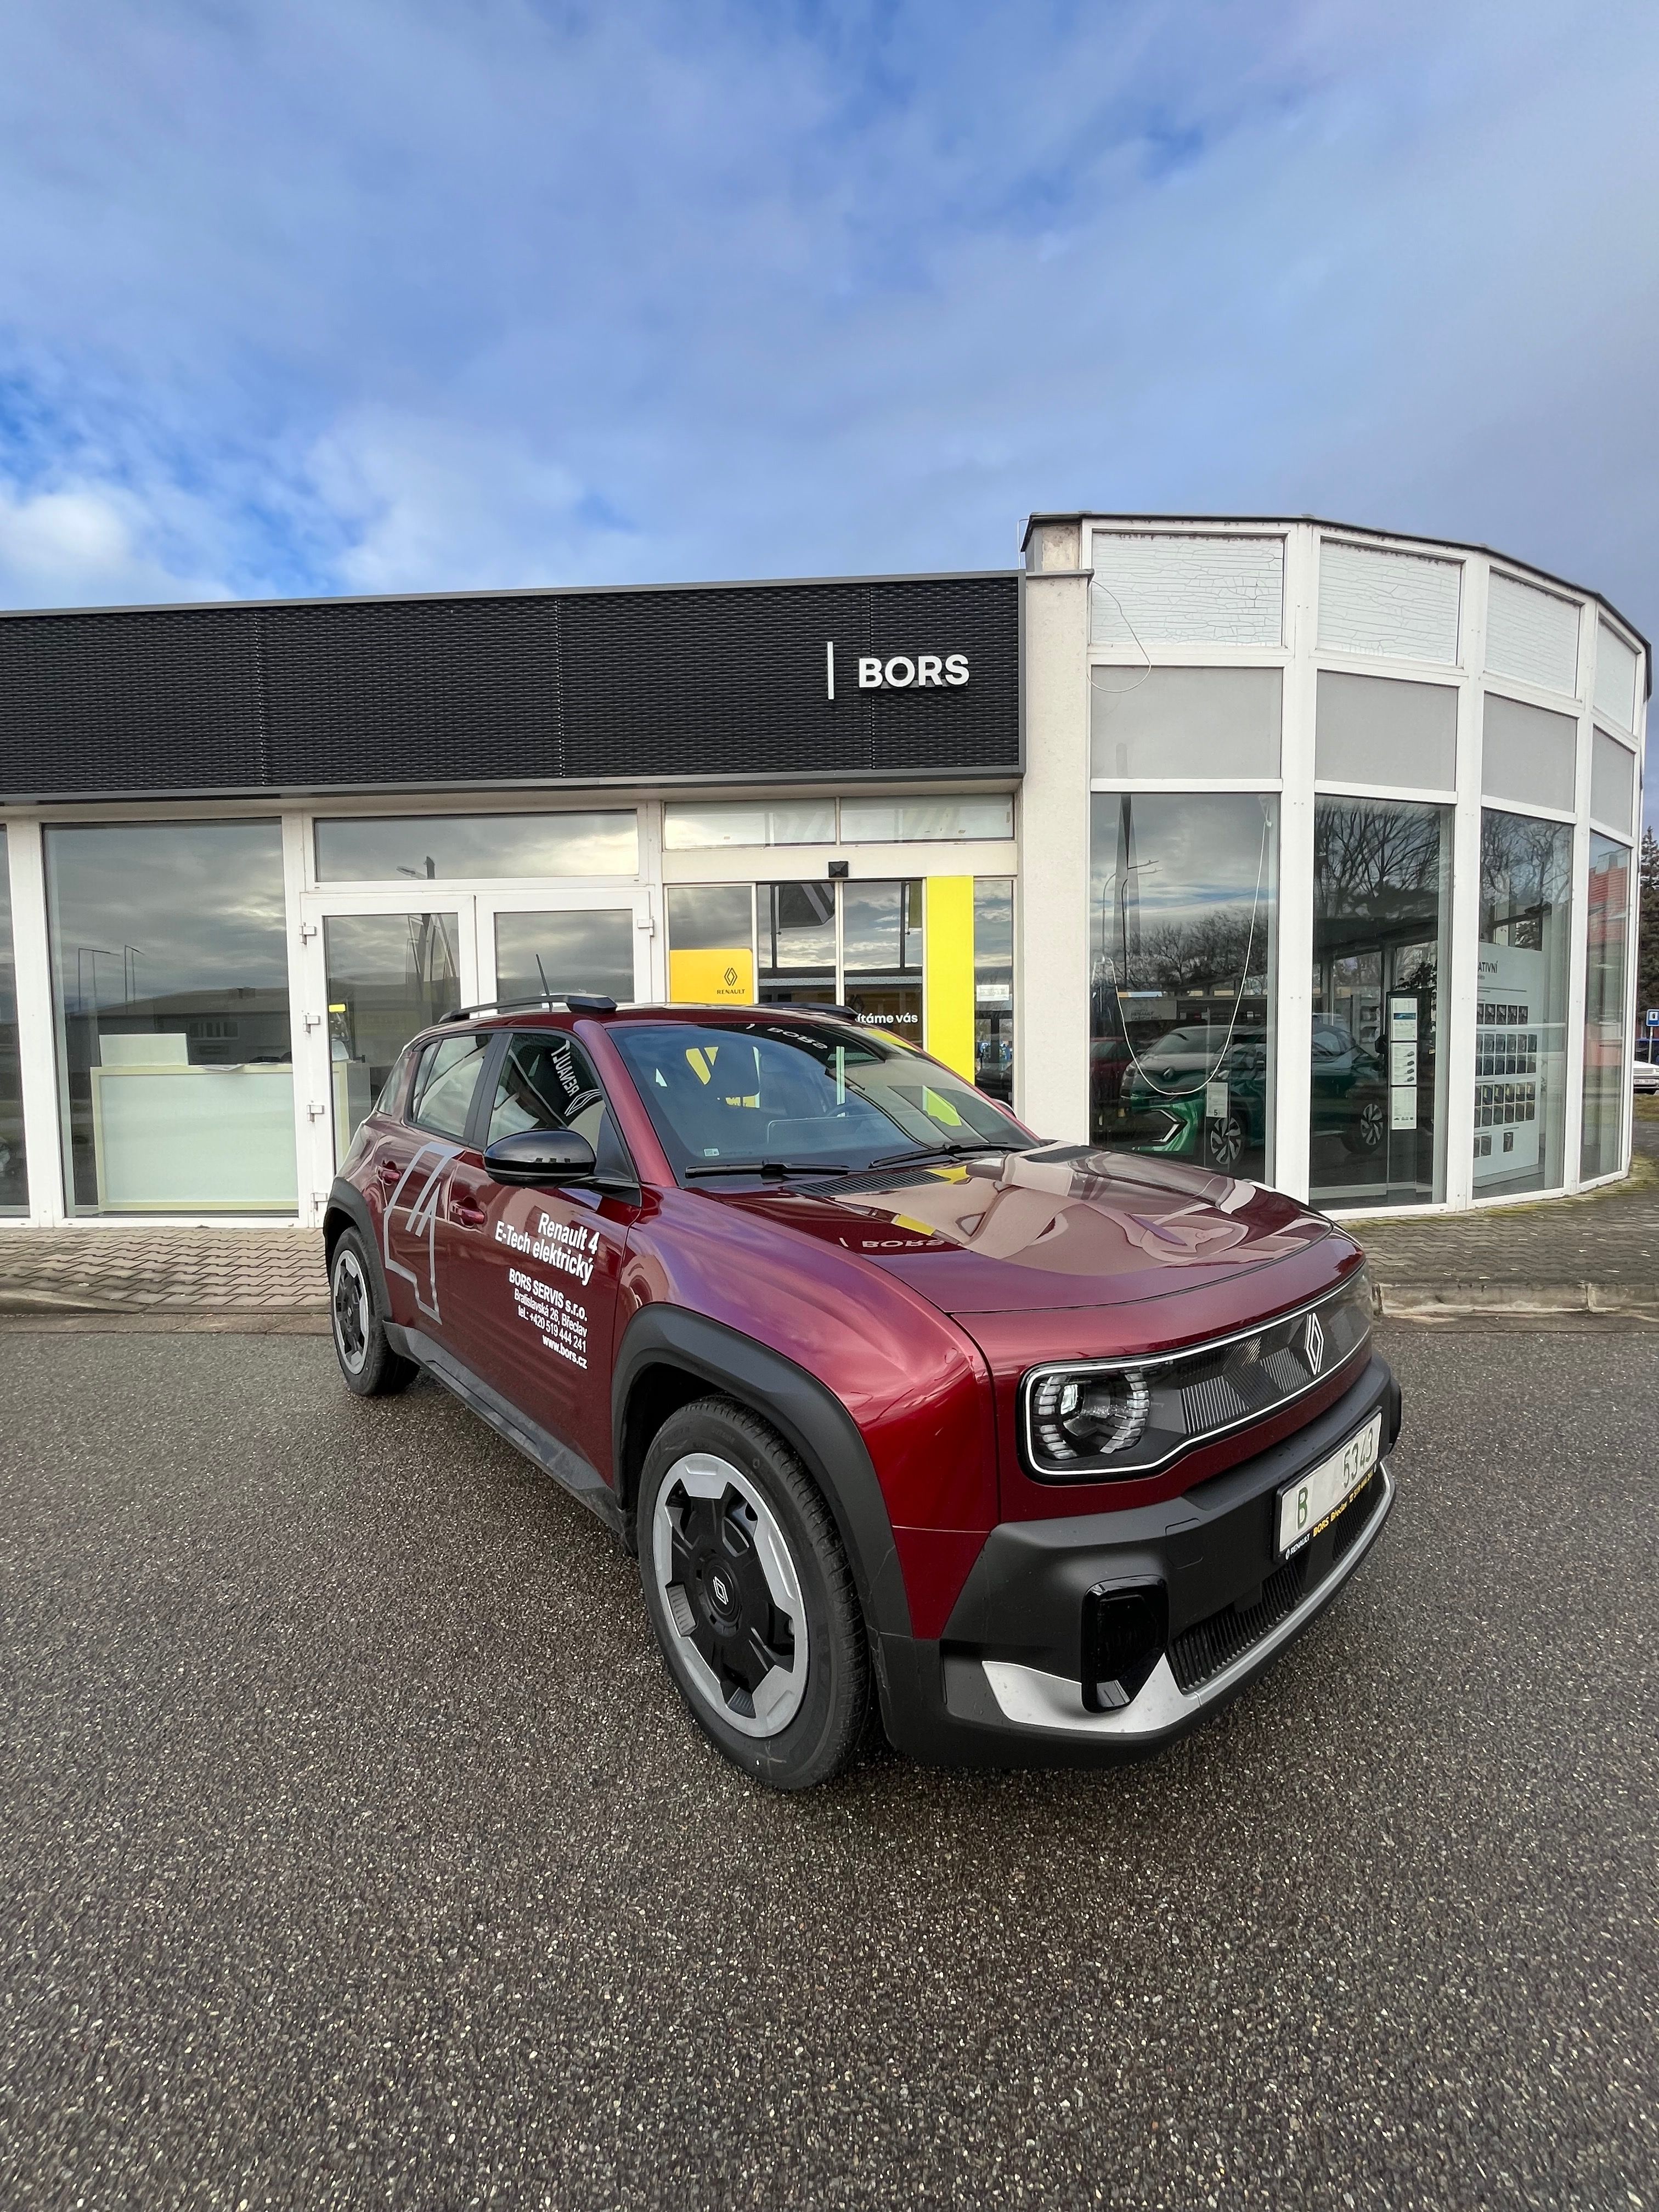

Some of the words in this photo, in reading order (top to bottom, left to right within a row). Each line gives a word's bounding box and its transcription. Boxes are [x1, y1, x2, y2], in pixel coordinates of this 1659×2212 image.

[859, 654, 970, 688] BORS
[855, 1013, 894, 1024] ítáme
[895, 1012, 918, 1023] vás
[495, 1220, 531, 1254] E-Tech
[533, 1238, 594, 1286] elektrický
[538, 1212, 588, 1251] Renault
[588, 1232, 600, 1255] 4
[509, 1268, 532, 1292] BORS
[532, 1280, 564, 1308] SERVIS
[565, 1300, 588, 1321] s.r.o.
[514, 1288, 549, 1317] Bratislavská
[550, 1307, 560, 1325] 26,
[561, 1313, 588, 1338] Břeclav
[529, 1313, 545, 1329] +420
[546, 1320, 558, 1337] 519
[559, 1328, 572, 1345] 444
[573, 1335, 586, 1353] 241
[542, 1334, 588, 1369] www.bors.cz
[1297, 1486, 1308, 1530] B
[1313, 1516, 1329, 1537] BORS
